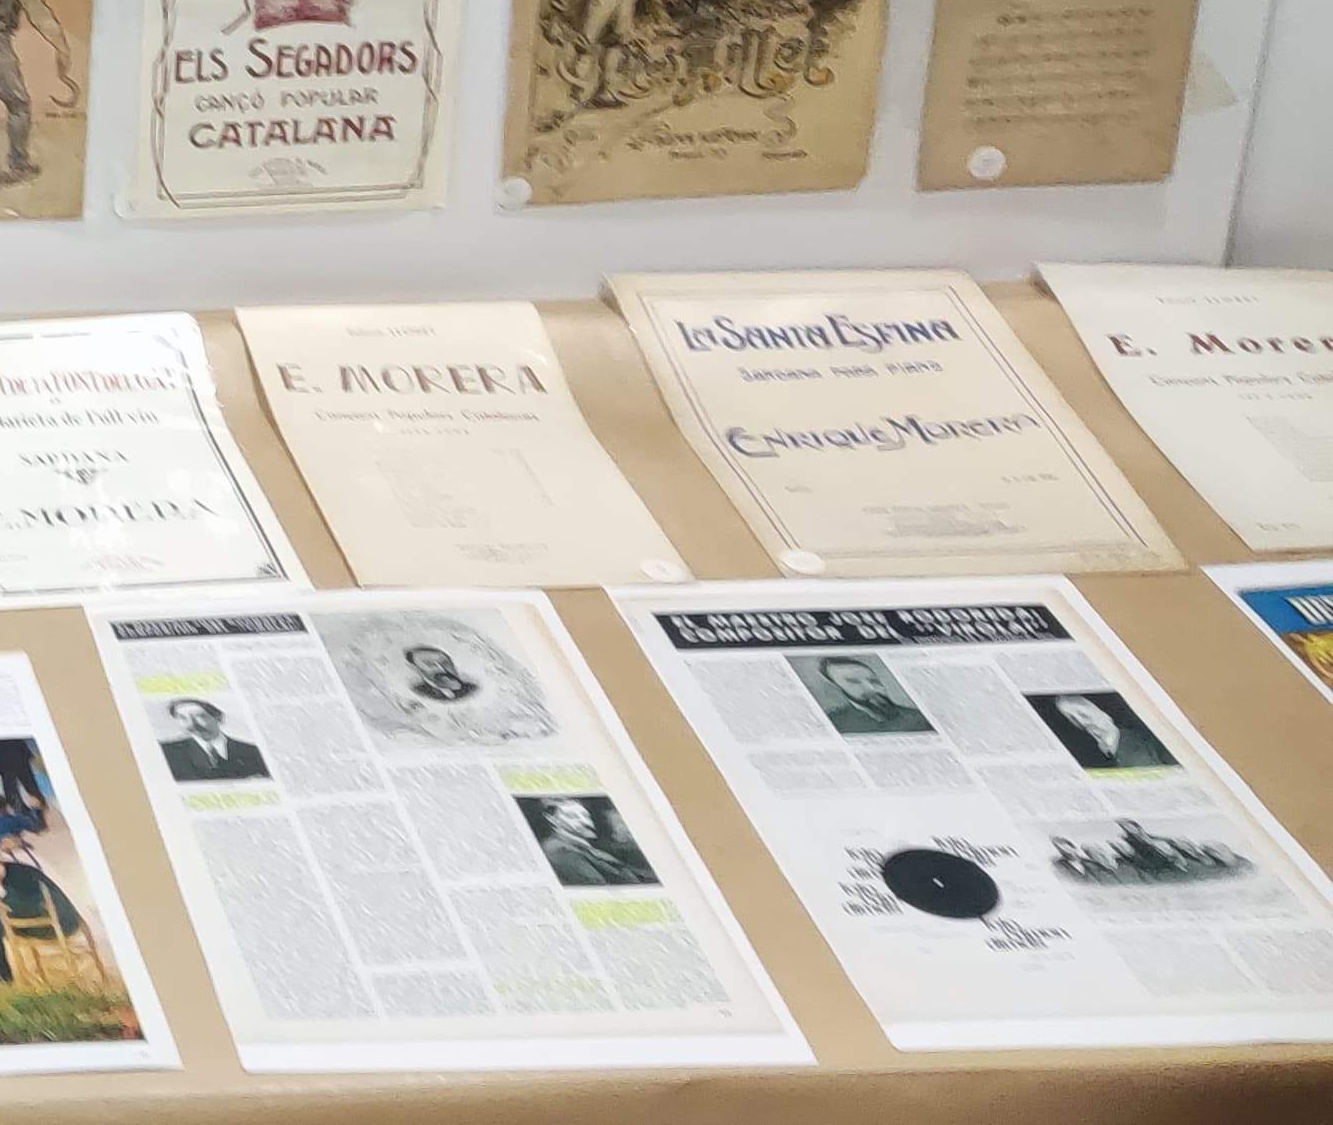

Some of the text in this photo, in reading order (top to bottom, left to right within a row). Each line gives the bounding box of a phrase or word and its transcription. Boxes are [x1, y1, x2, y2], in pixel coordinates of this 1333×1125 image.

[174, 37, 420, 84] ELS SEGADORS
[280, 86, 380, 110] POPULAR
[188, 115, 398, 150] CATALANA
[1106, 330, 1333, 357] E. Morer
[277, 363, 549, 395] E. MORERA
[680, 625, 845, 643] COMPOSITOR
